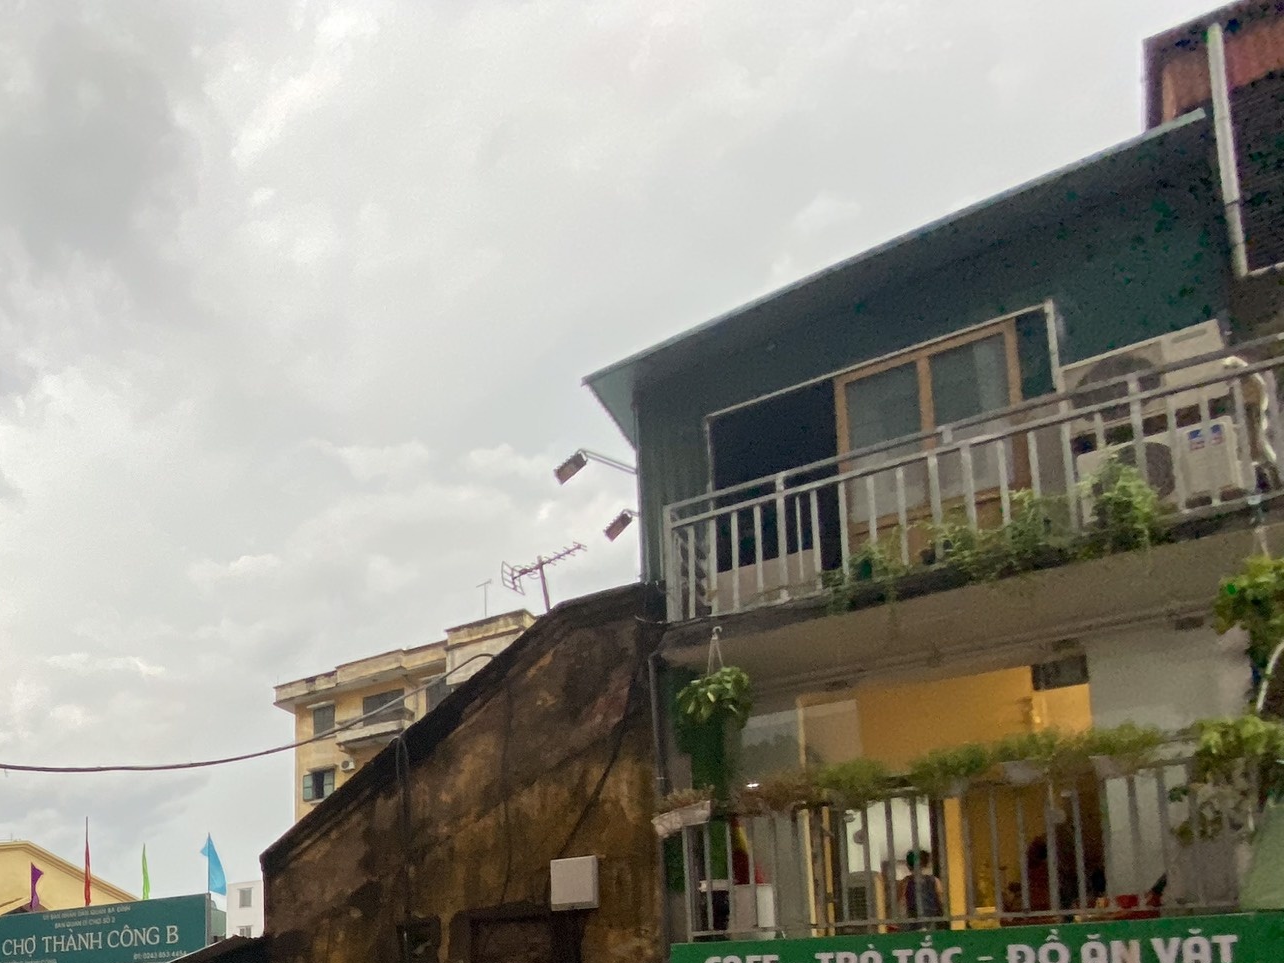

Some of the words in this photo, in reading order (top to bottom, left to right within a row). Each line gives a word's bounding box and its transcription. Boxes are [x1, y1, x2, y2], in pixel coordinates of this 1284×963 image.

[1, 934, 37, 958] CHỢ
[41, 928, 103, 954] THÀNH
[106, 924, 161, 949] CÔNG
[165, 925, 179, 945] B
